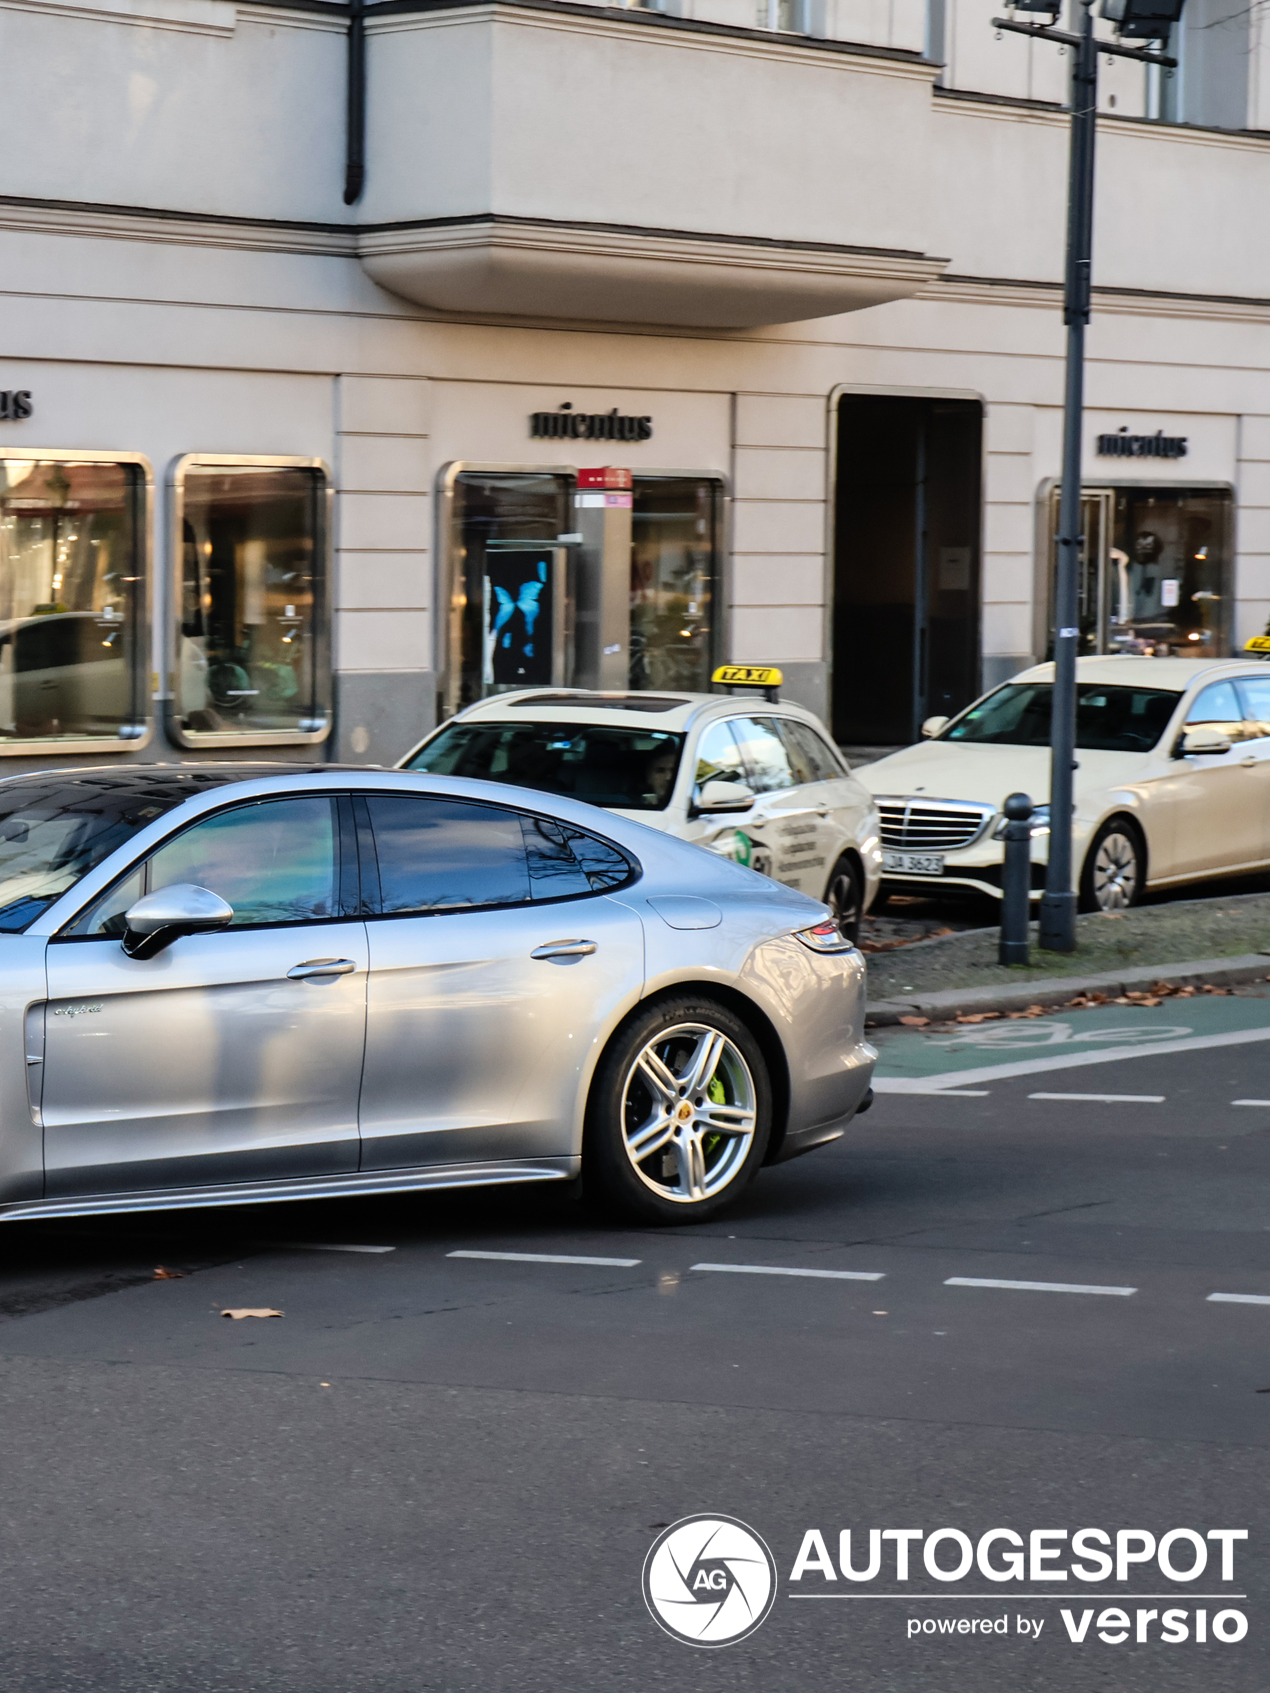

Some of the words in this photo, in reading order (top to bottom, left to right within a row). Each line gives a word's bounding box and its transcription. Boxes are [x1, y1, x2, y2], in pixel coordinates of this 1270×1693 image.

[530, 402, 652, 440] mientus
[1097, 426, 1188, 458] mientus
[722, 668, 771, 682] TAXI
[908, 857, 941, 872] 3623
